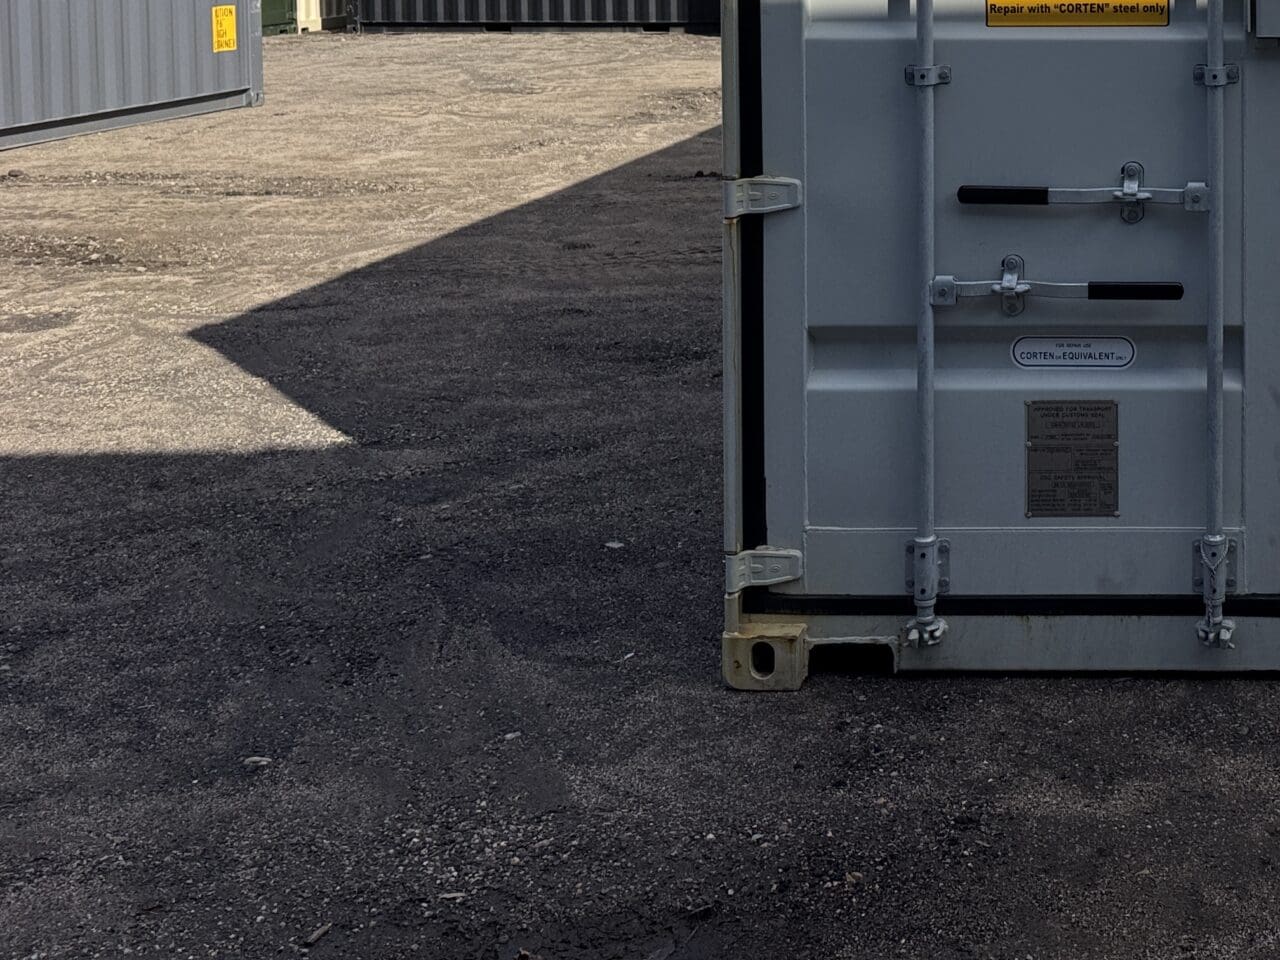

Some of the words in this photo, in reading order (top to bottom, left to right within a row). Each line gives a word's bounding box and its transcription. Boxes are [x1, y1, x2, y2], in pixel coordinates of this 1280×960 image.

[990, 4, 1024, 15] Repair
[1027, 3, 1050, 13] with
[1113, 3, 1139, 13] steel
[1143, 3, 1165, 15] only
[1020, 352, 1054, 360] CORTEN
[1062, 352, 1115, 361] EQUIVALENT
